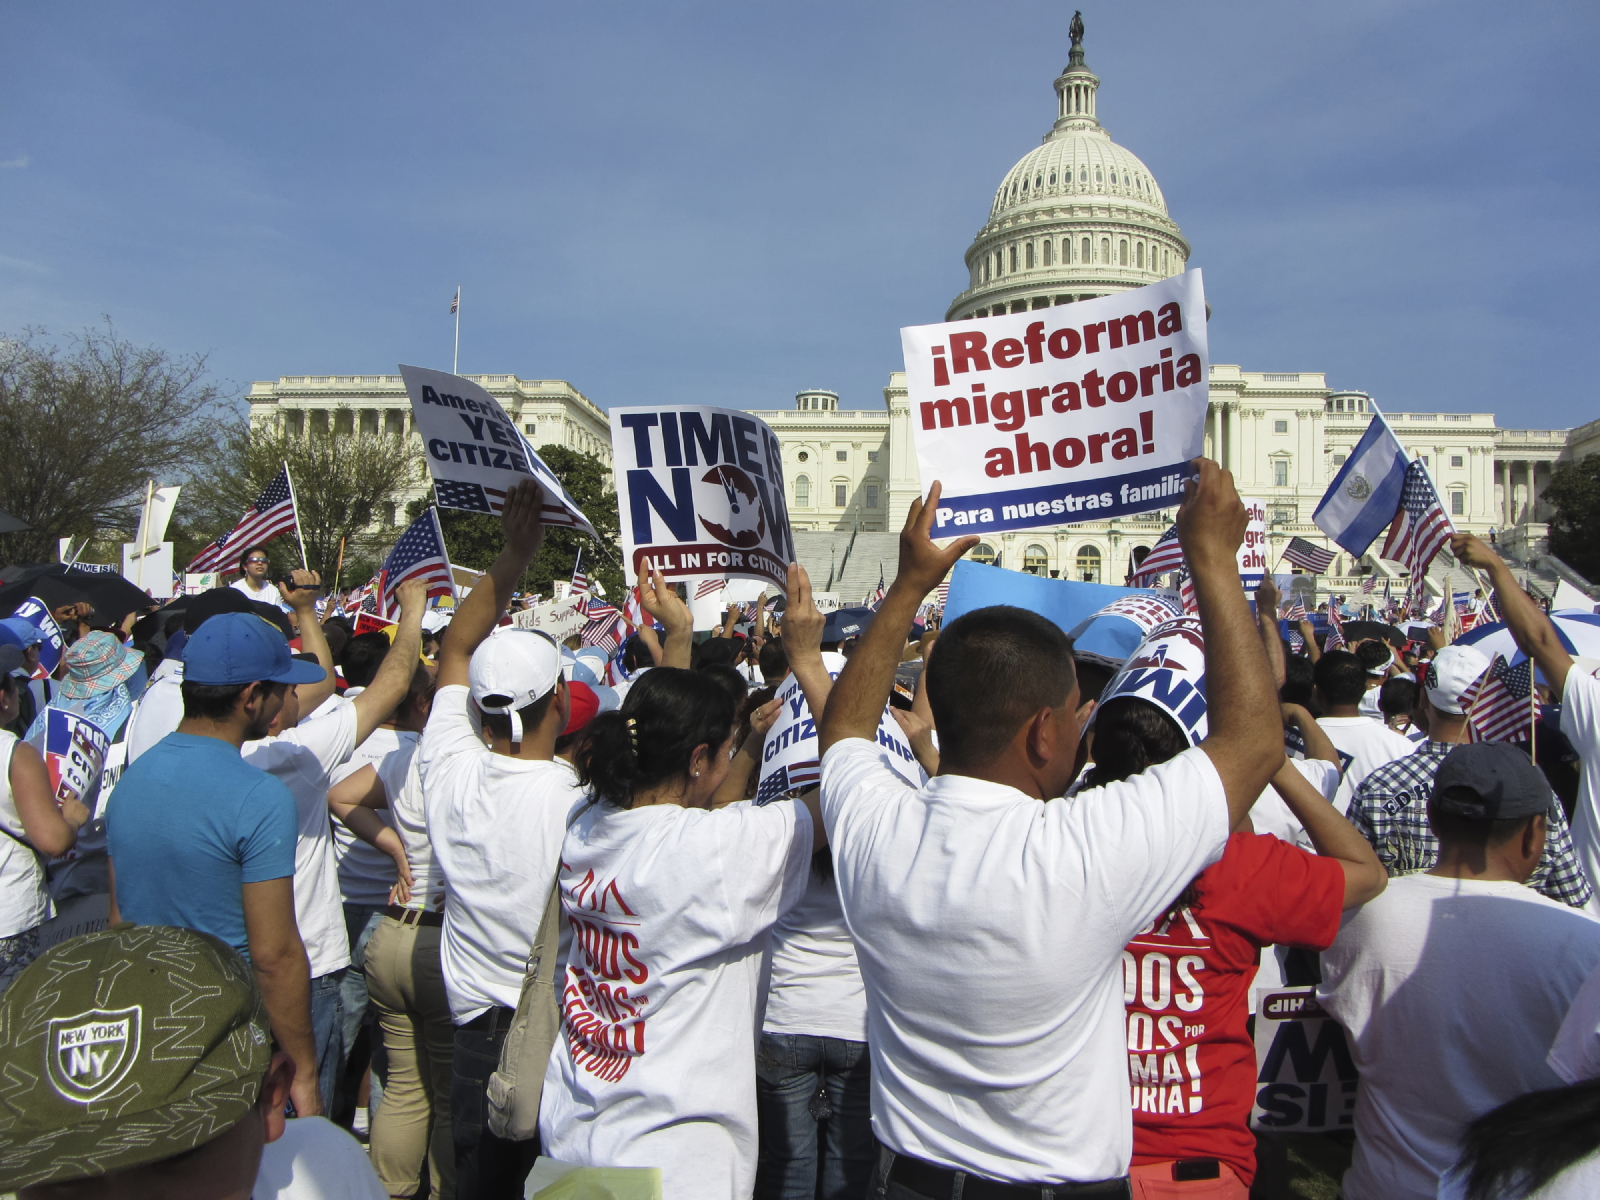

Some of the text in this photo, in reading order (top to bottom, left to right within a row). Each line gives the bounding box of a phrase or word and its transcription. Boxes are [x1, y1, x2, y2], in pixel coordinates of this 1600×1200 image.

[931, 302, 1183, 387] ¡Reforma
[422, 385, 511, 425] Americ
[920, 348, 1202, 432] migratoria
[428, 438, 531, 474] CITIZE
[620, 411, 784, 490] TIME IS
[984, 410, 1156, 478] ahora!
[935, 507, 994, 528] Para
[1002, 491, 1114, 520] nuestras
[681, 553, 701, 569] IN
[706, 551, 744, 568] FOR
[748, 554, 788, 586] CITIZEN
[518, 610, 541, 629] Kids
[765, 717, 817, 762] CITIZ
[61, 1023, 125, 1046] NEW YORK
[1184, 1024, 1205, 1039] POR
[67, 1043, 111, 1079] NY
